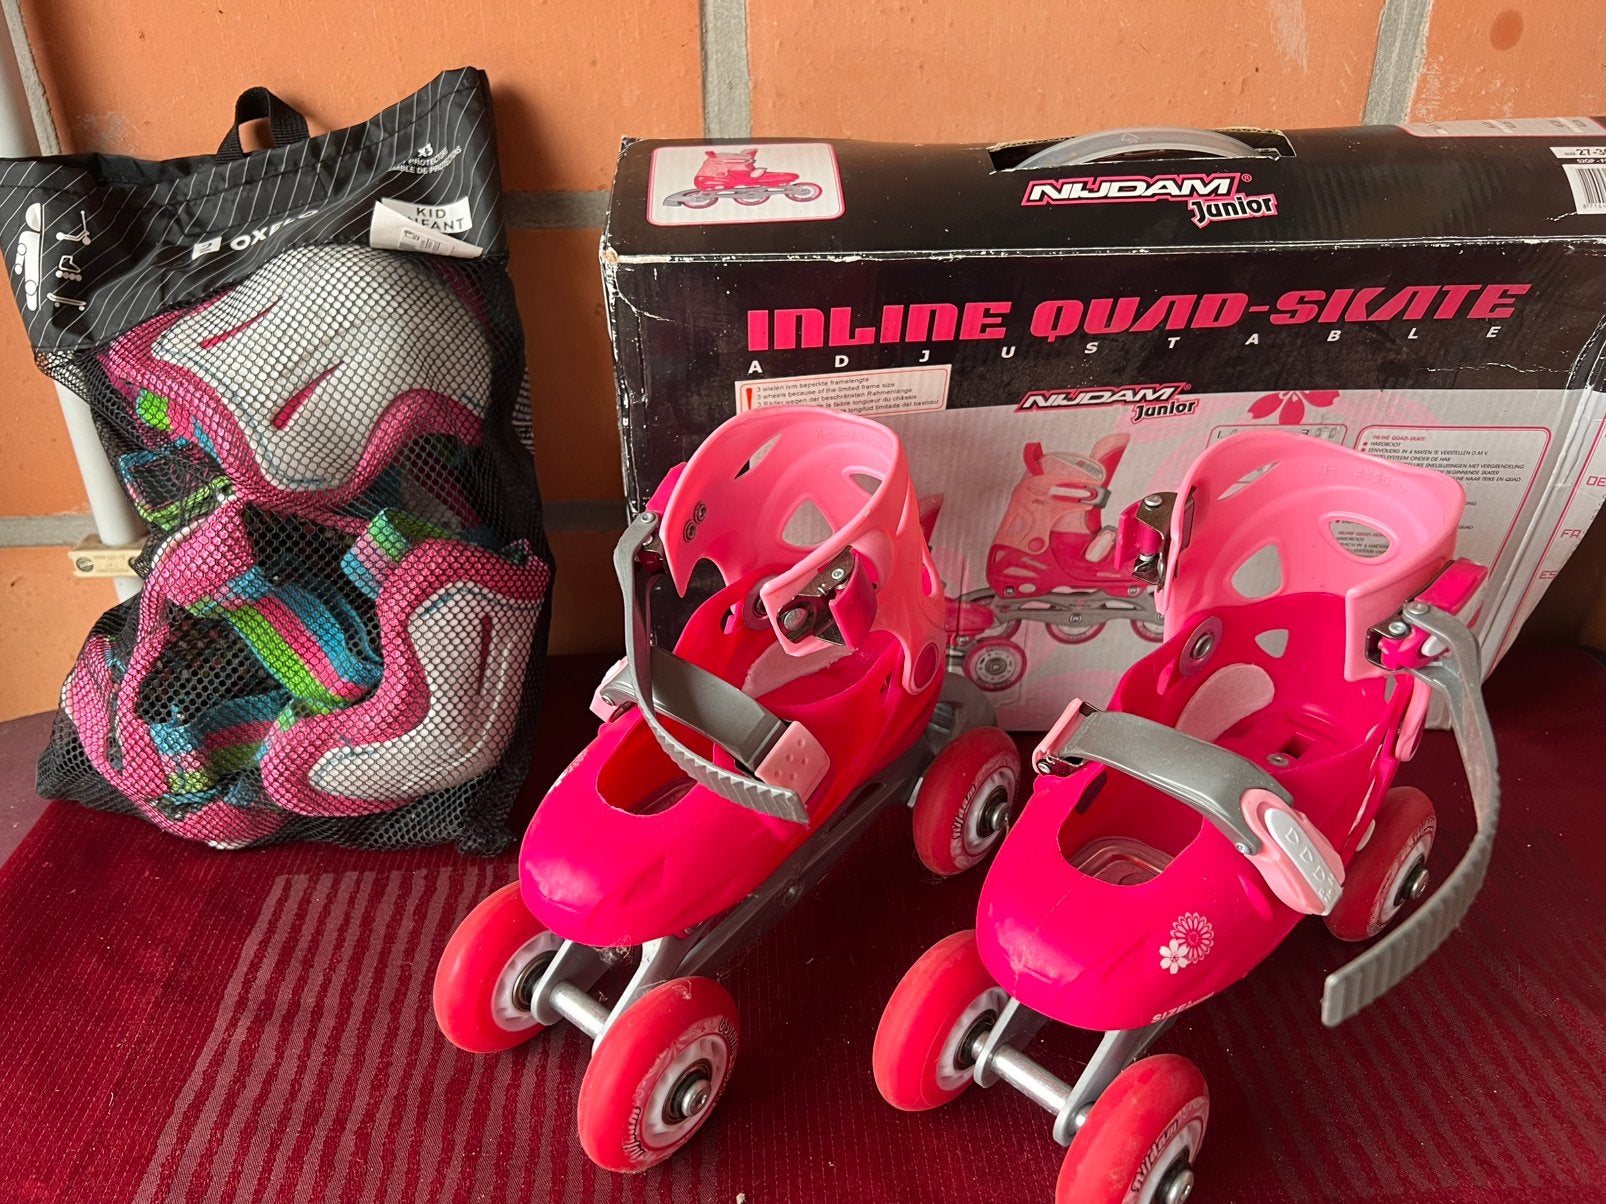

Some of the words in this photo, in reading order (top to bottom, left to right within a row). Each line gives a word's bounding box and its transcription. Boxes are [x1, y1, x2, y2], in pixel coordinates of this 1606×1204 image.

[1028, 176, 1234, 202] NIJDAM
[416, 206, 446, 219] KID
[1190, 195, 1275, 224] Junior
[747, 301, 1013, 351] INLINE
[1030, 283, 1532, 342] QUAD-SKATE
[762, 384, 784, 392] wielen
[800, 380, 828, 389] beperkte
[830, 377, 869, 386] framelengte
[763, 391, 786, 400] wheels
[788, 388, 816, 398] because
[862, 383, 880, 391] frame
[821, 392, 865, 401] beschränkten
[853, 398, 881, 406] longueur
[1020, 386, 1178, 410] NIJDAM
[848, 404, 873, 413] longitud
[875, 402, 900, 410] limitada
[1133, 400, 1196, 422] Junior
